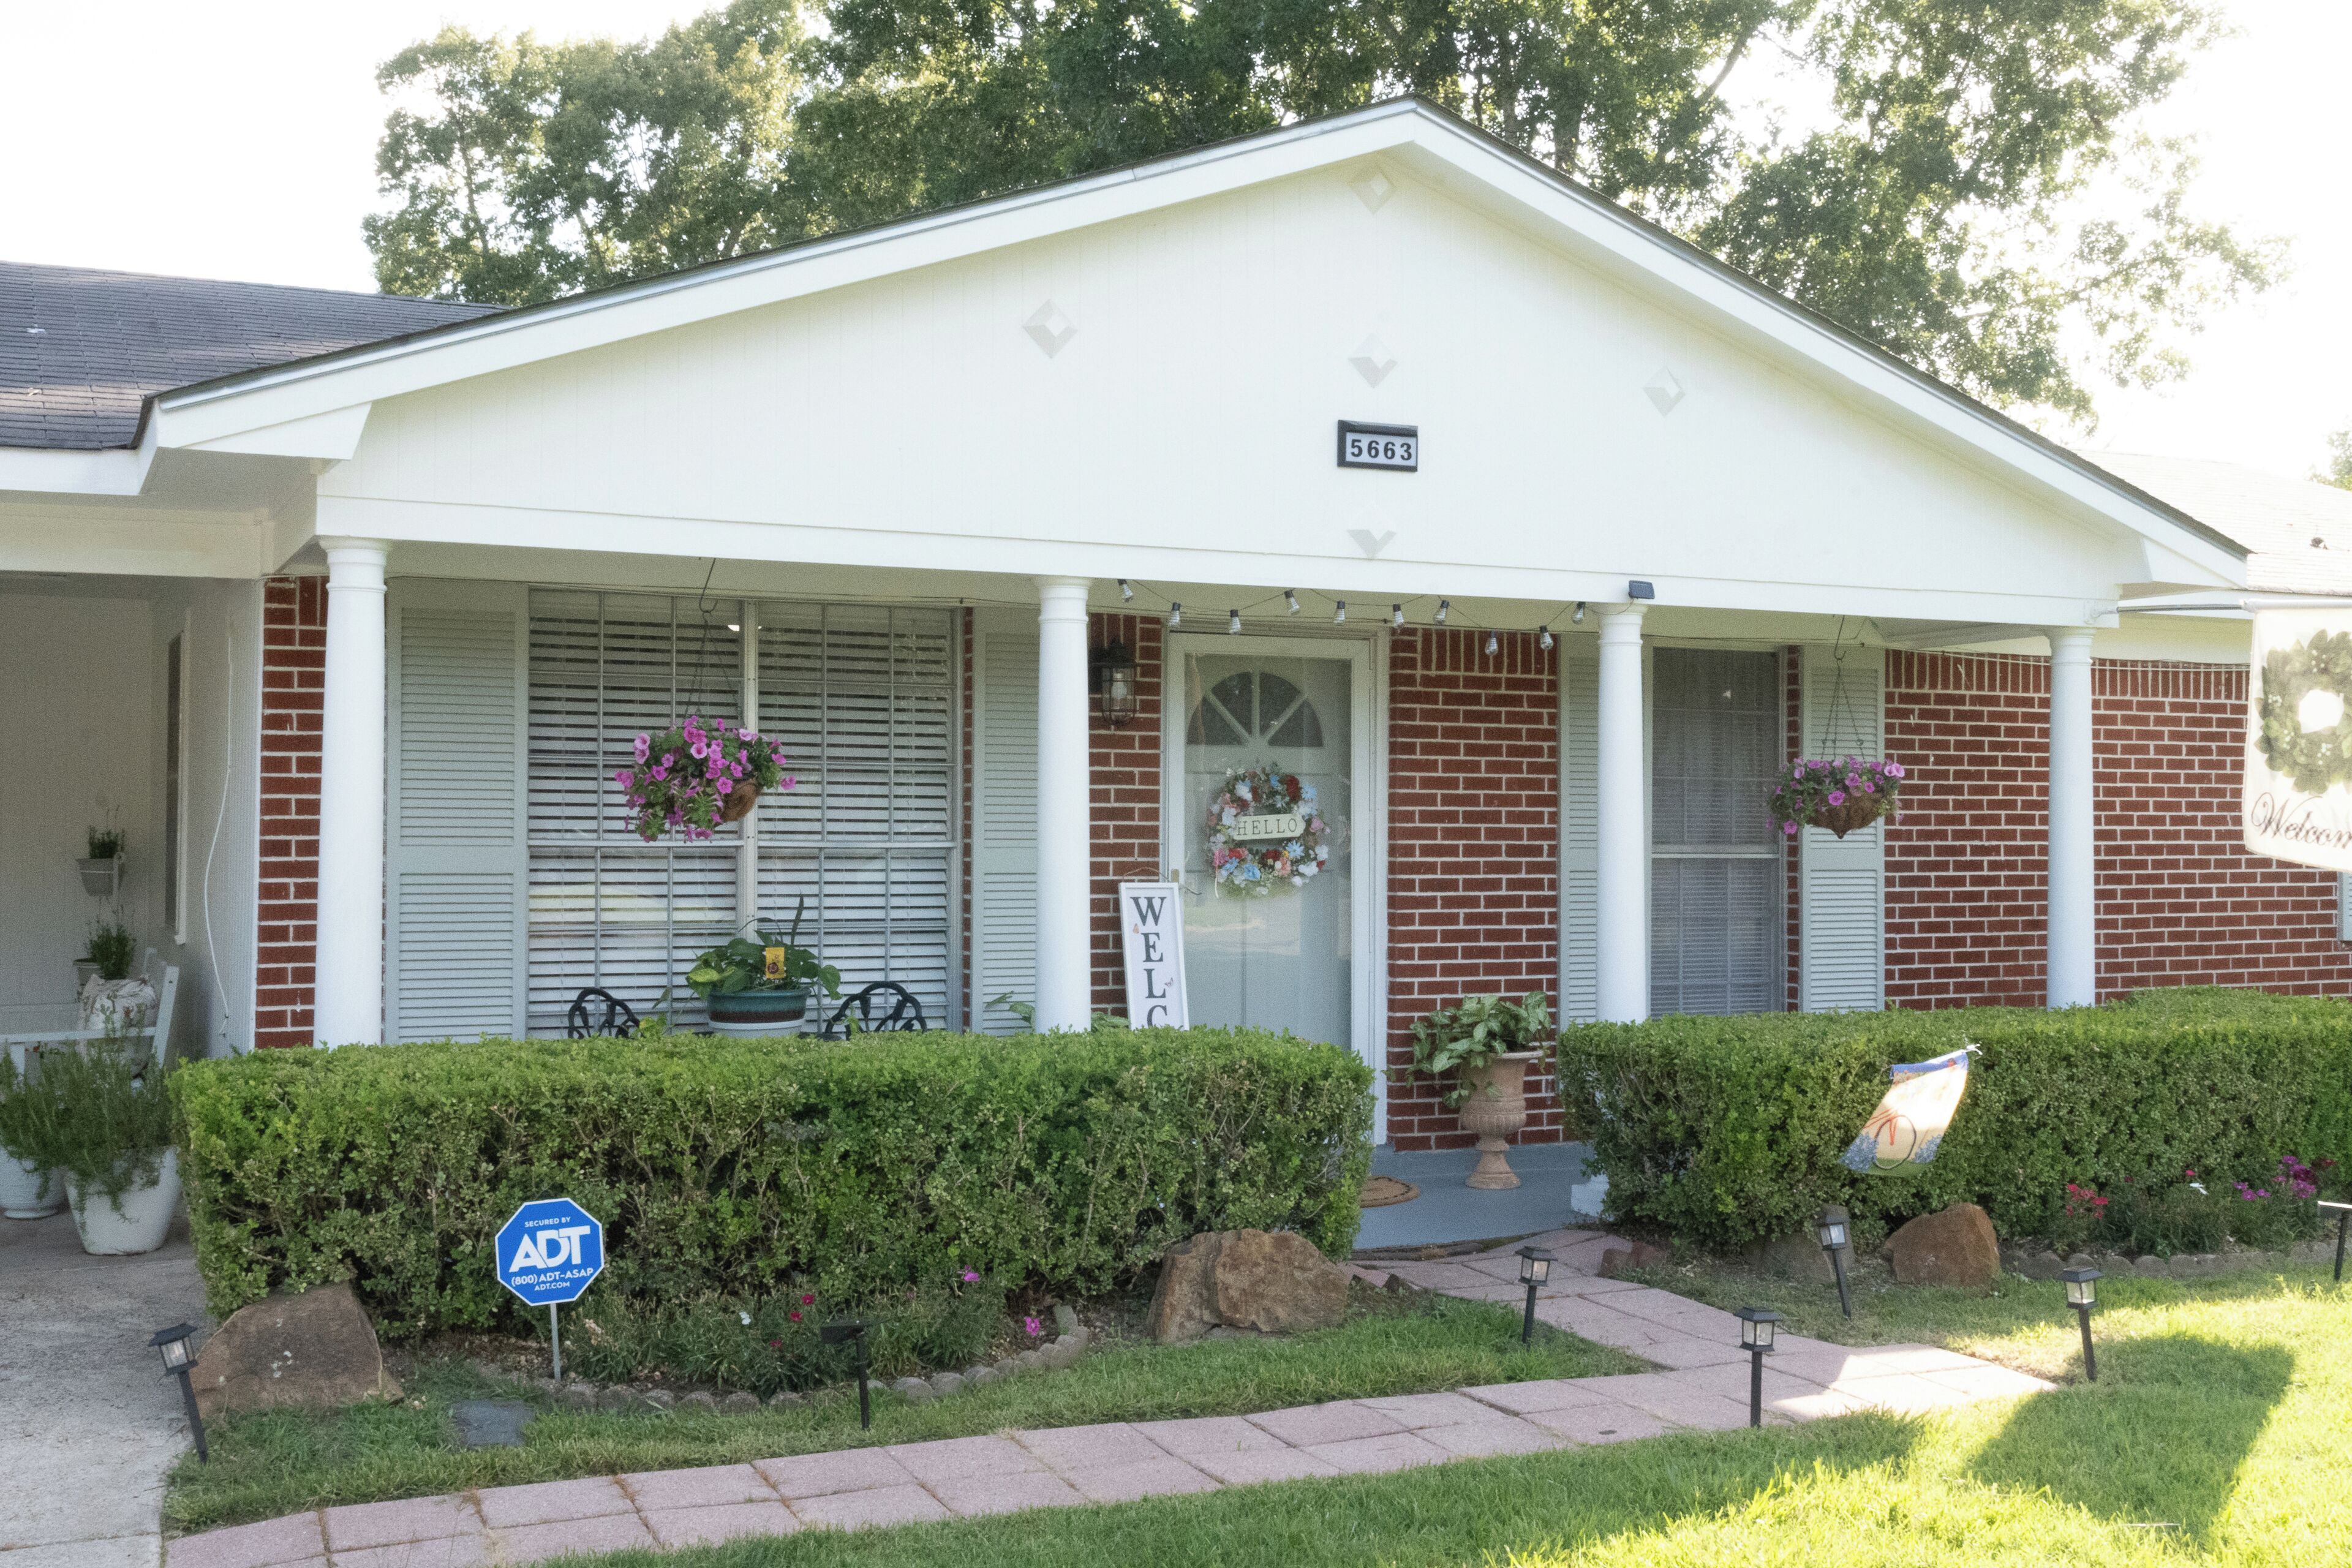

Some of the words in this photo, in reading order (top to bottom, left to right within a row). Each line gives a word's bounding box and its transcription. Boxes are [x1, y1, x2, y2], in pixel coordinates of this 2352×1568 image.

[1351, 439, 1412, 461] 5663
[1237, 818, 1297, 835] HELLO
[1130, 896, 1168, 1028] WELC
[524, 1218, 560, 1227] SECURED
[509, 1225, 591, 1273] ADT
[511, 1273, 538, 1287] (800)
[539, 1267, 594, 1283] ADT-ASAP
[534, 1281, 570, 1291] ADT.COM
